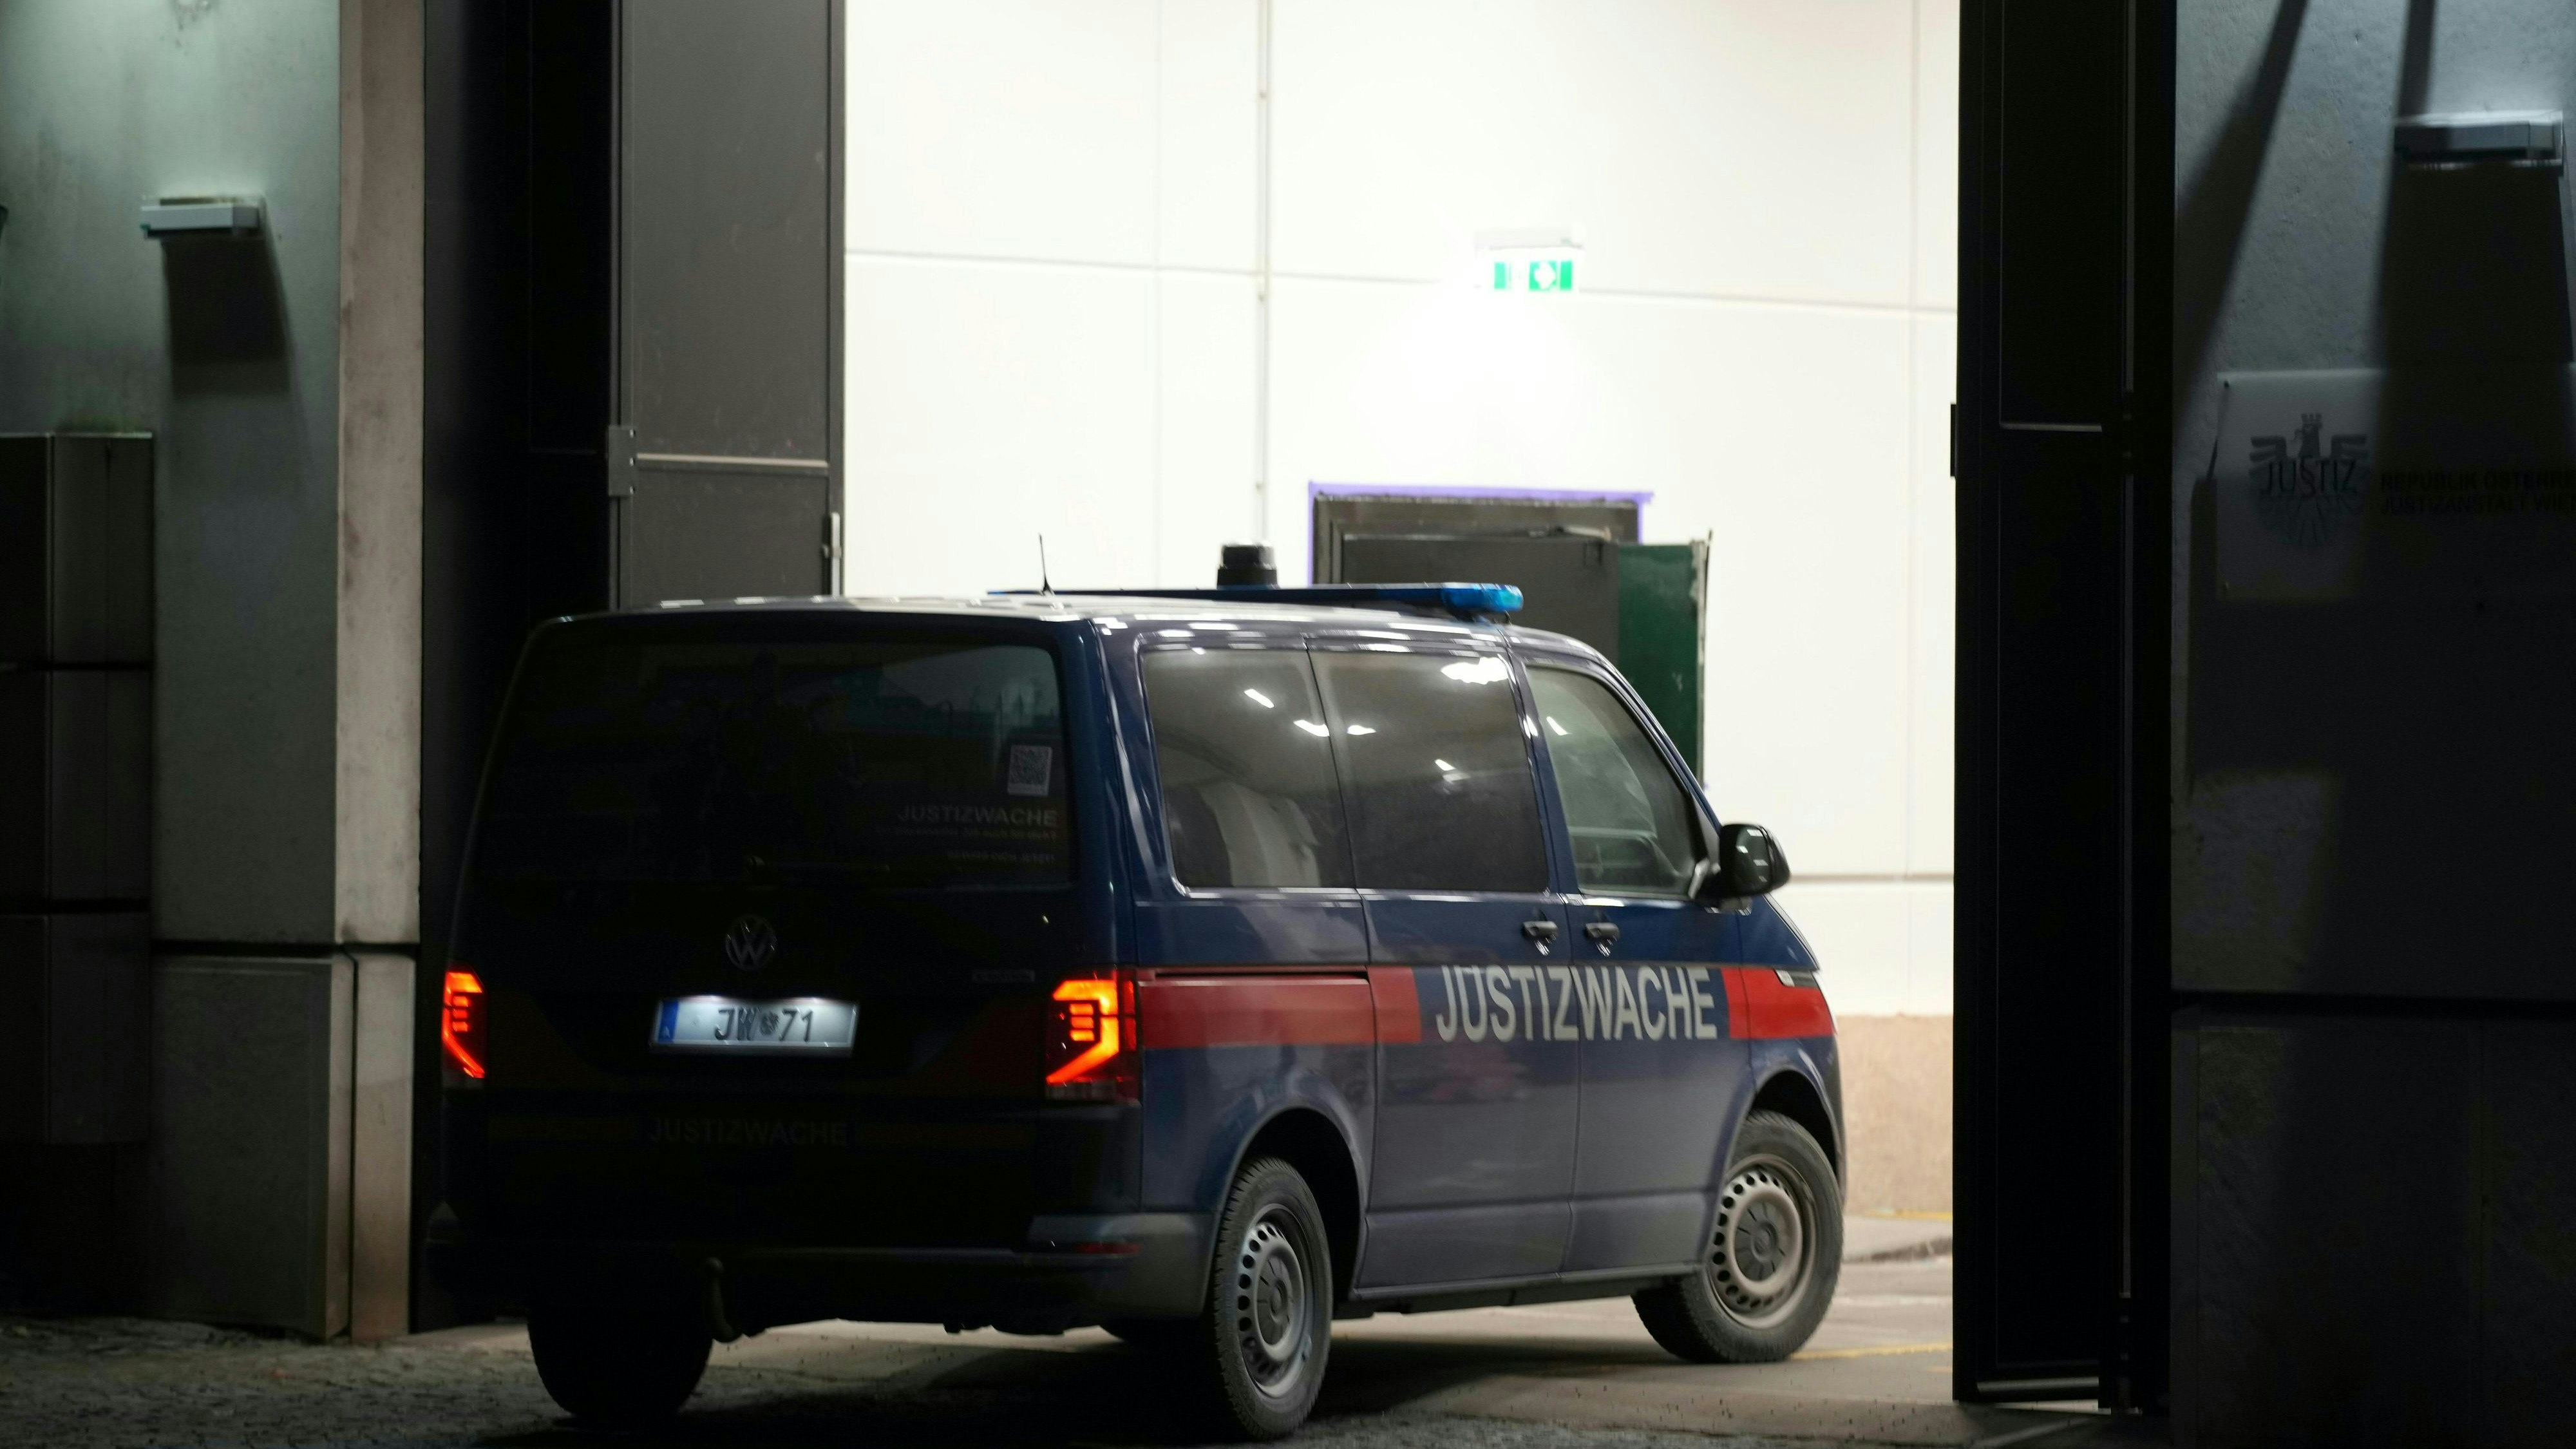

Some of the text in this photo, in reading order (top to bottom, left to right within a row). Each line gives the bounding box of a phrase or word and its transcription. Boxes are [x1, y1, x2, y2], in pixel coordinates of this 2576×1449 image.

[2259, 455, 2358, 498] JUSTIZ
[897, 804, 1058, 828] JUSTIZWACHE
[1435, 964, 1718, 1043] JUSTIZWACHE
[648, 1117, 848, 1146] JUSTIZWACHE
